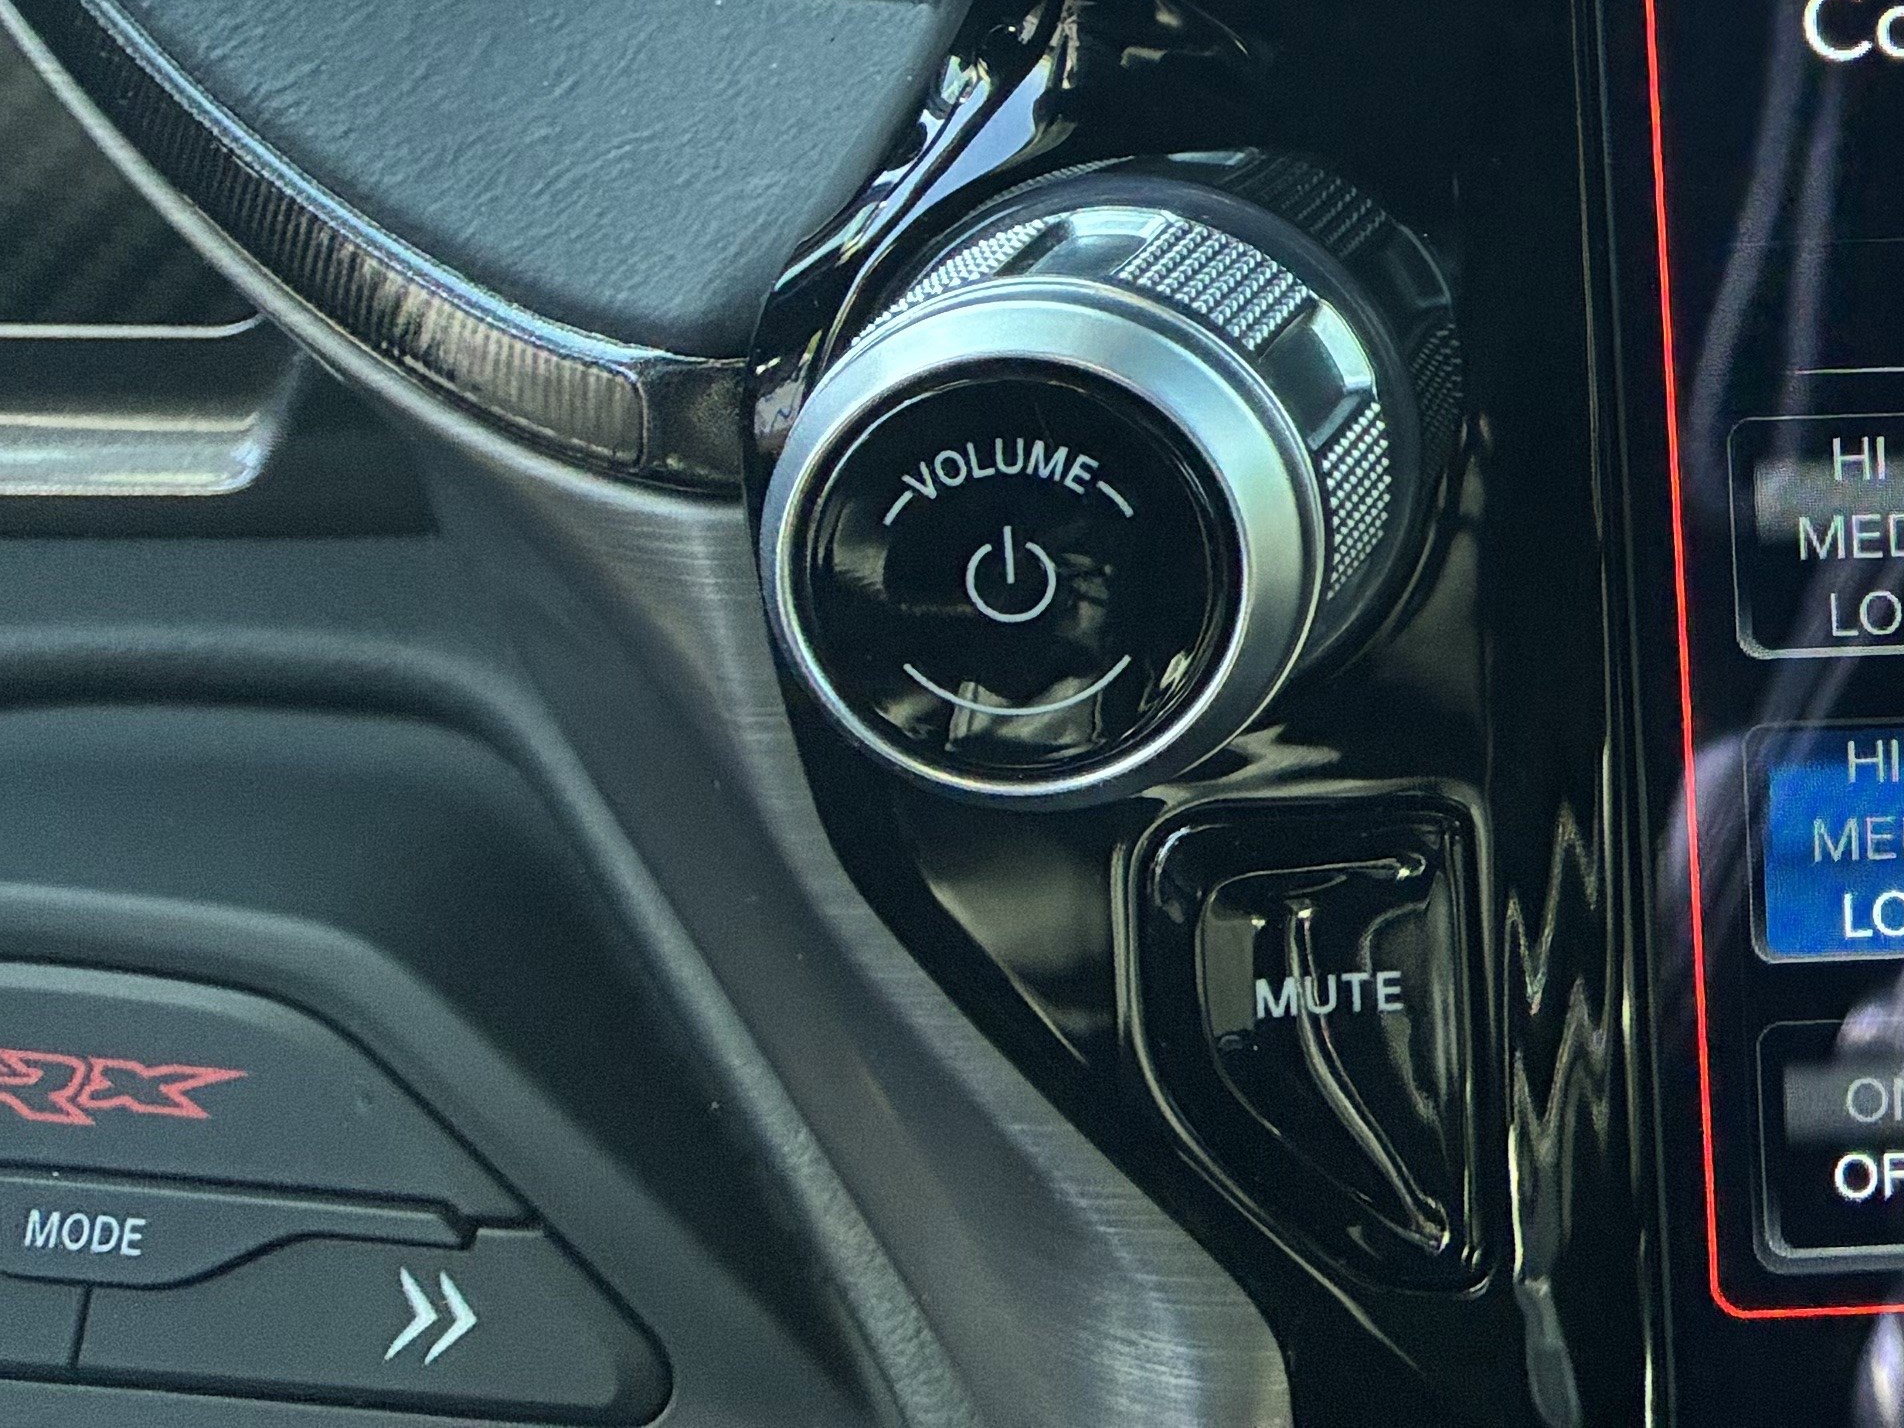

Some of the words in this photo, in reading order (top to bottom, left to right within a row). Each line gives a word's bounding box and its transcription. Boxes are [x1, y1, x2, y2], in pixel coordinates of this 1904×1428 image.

[904, 438, 1099, 500] VOLUME
[1833, 436, 1885, 481] HI
[1831, 590, 1902, 636] LO
[1848, 739, 1899, 783] HI
[1256, 973, 1404, 1019] MUTE
[24, 1209, 146, 1256] MODE
